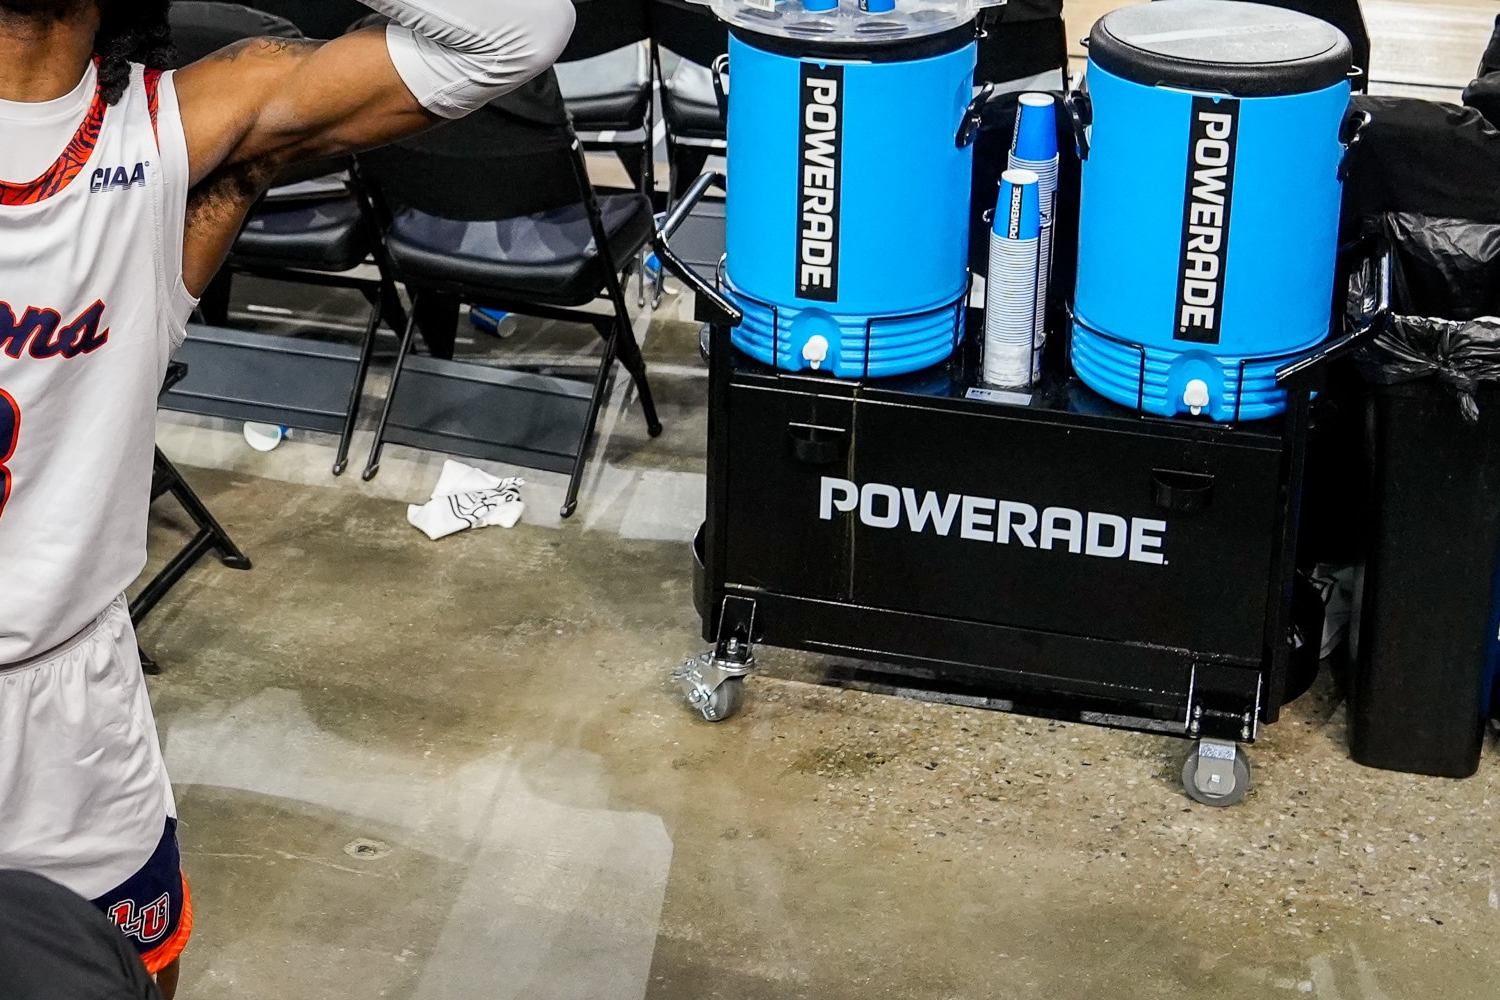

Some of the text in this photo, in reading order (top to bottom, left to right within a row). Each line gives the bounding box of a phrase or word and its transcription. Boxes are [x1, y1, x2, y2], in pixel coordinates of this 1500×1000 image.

[90, 162, 146, 194] CIAA
[801, 77, 838, 289] POWERADE
[1009, 185, 1023, 239] POWERADE
[1181, 111, 1232, 330] POWERADE
[819, 475, 1167, 565] POWERADE
